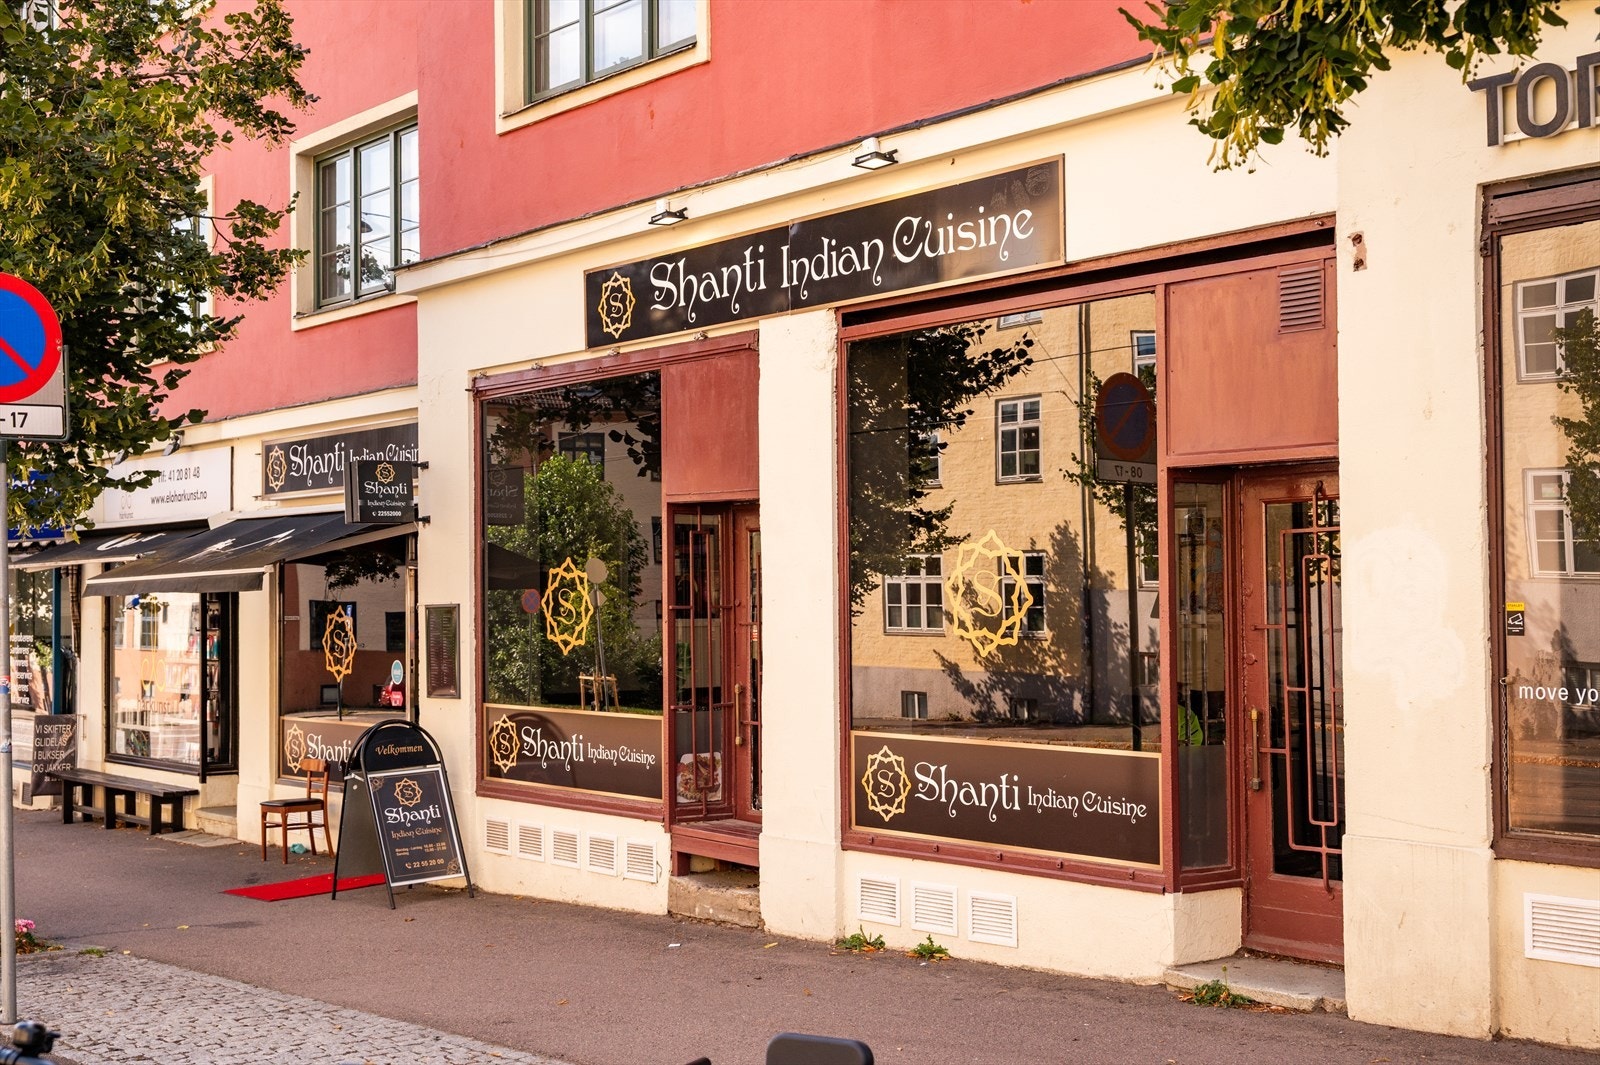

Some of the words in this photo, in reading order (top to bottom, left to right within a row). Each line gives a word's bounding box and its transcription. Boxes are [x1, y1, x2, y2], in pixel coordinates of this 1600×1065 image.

[650, 244, 767, 323] Shanti
[781, 237, 885, 300] Indian
[892, 205, 1035, 263] Cuisine
[11, 411, 28, 428] 17
[289, 442, 345, 487] Shanti
[364, 480, 407, 498] Shanti
[385, 499, 406, 508] Cuisine
[1519, 685, 1569, 701] move
[1576, 687, 1599, 706] yo
[43, 724, 72, 734] SKIFTER
[38, 750, 65, 760] BUKSER
[307, 733, 351, 771] Shanti
[375, 743, 424, 756] Velkommen
[521, 726, 585, 772] Shanti
[587, 742, 618, 767] Indian
[619, 745, 656, 769] Cuisine
[33, 763, 44, 773] OG
[914, 761, 1021, 823] Shanti
[1027, 786, 1079, 817] Indian
[1082, 791, 1148, 824] Cuisine
[384, 804, 442, 827] Shanti
[391, 829, 415, 840] Indian
[415, 826, 443, 838] Cuisine
